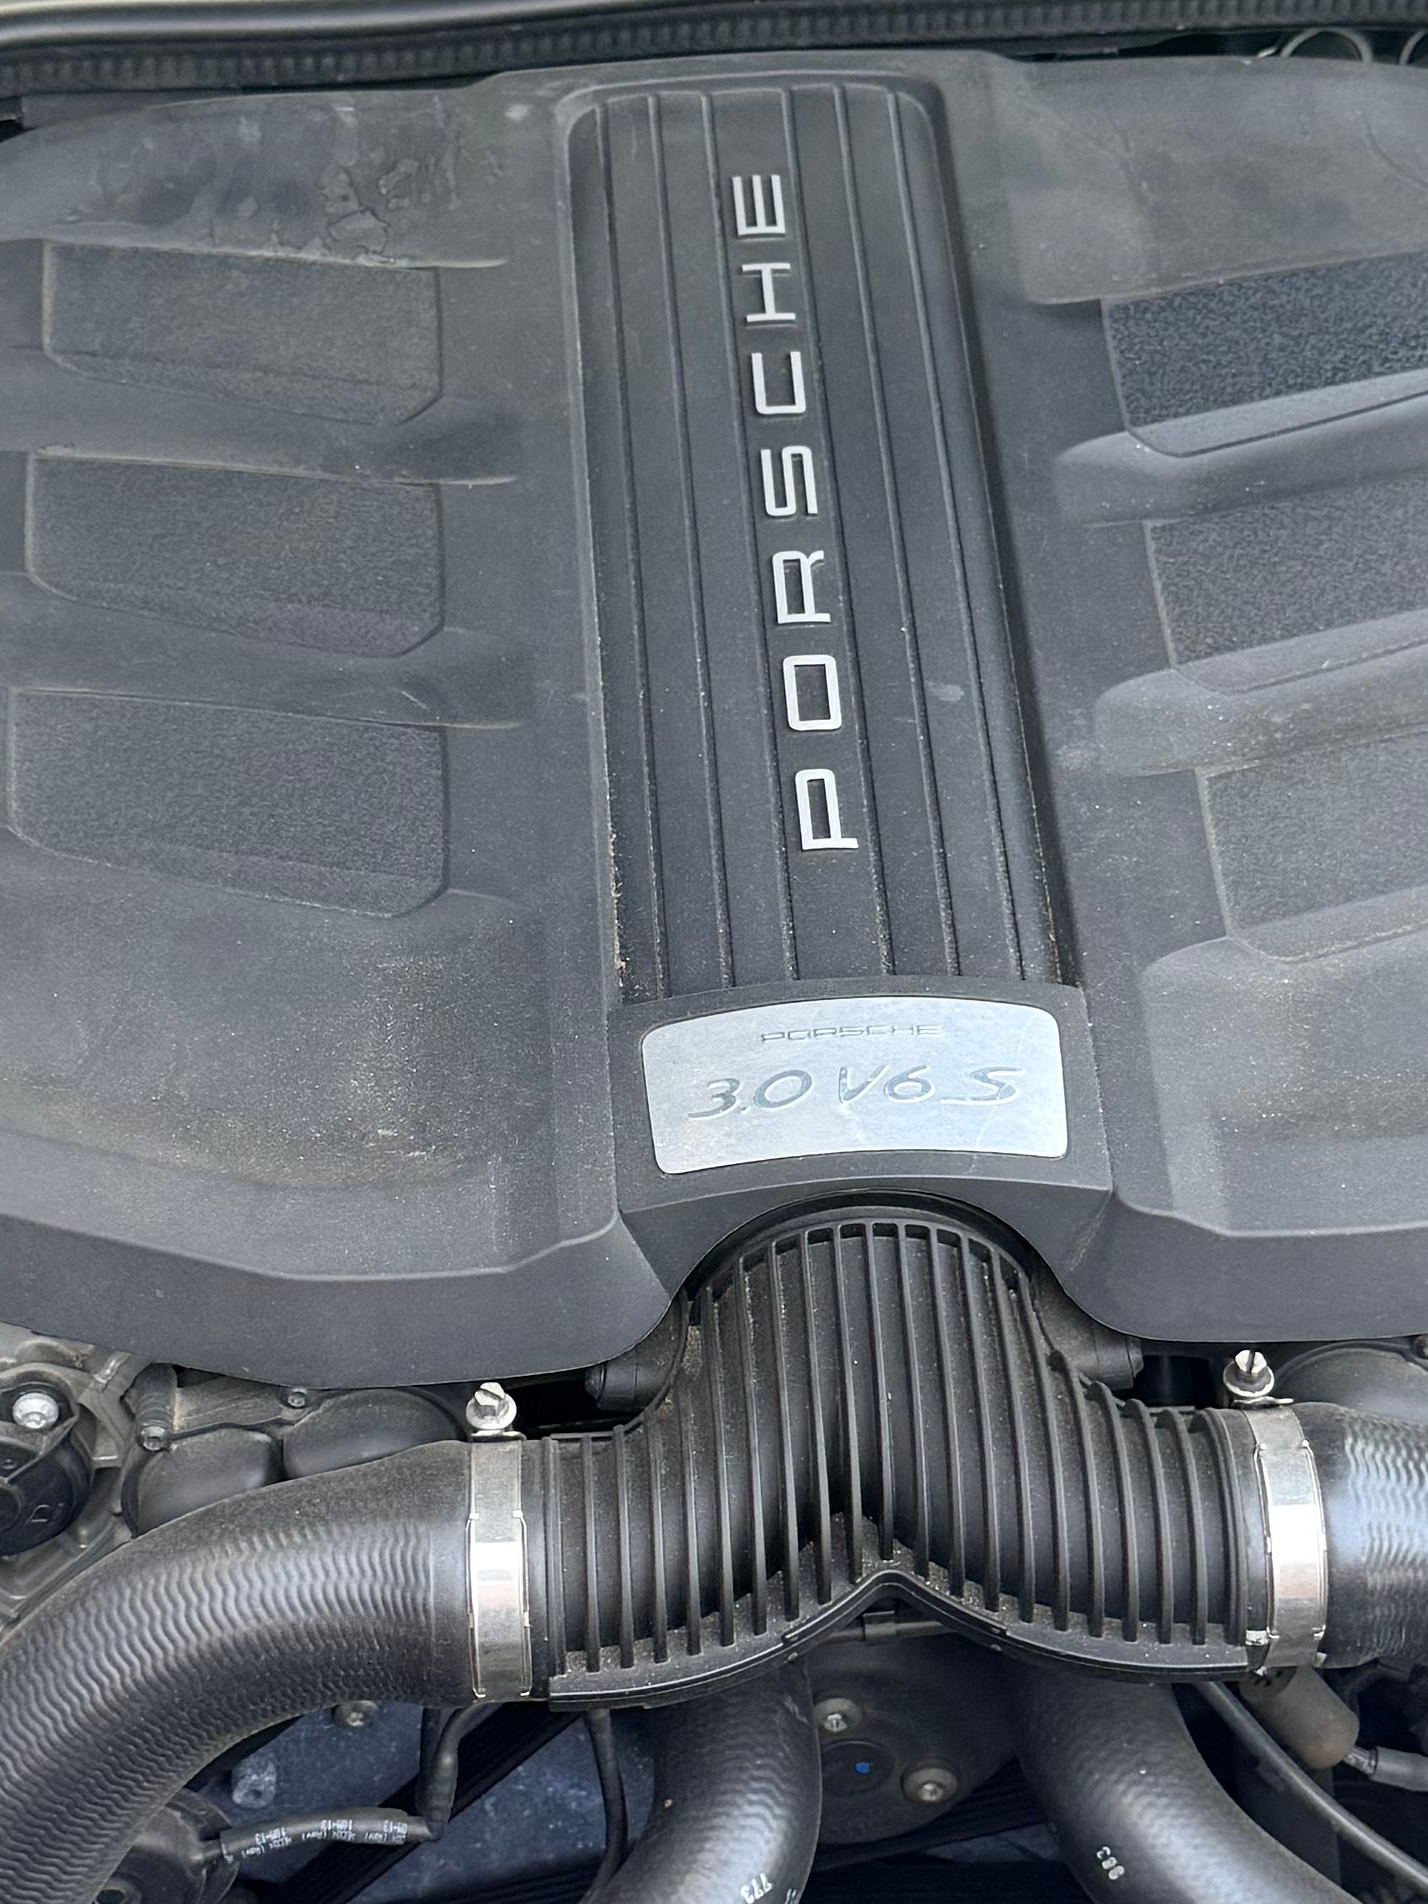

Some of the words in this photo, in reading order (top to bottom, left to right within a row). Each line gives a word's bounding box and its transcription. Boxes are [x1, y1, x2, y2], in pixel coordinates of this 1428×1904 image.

[732, 173, 859, 852] PORSCHE
[760, 1023, 944, 1044] PORSCHE
[687, 1069, 816, 1120] 3.0
[938, 1065, 1027, 1106] S
[740, 1873, 774, 1904] 773
